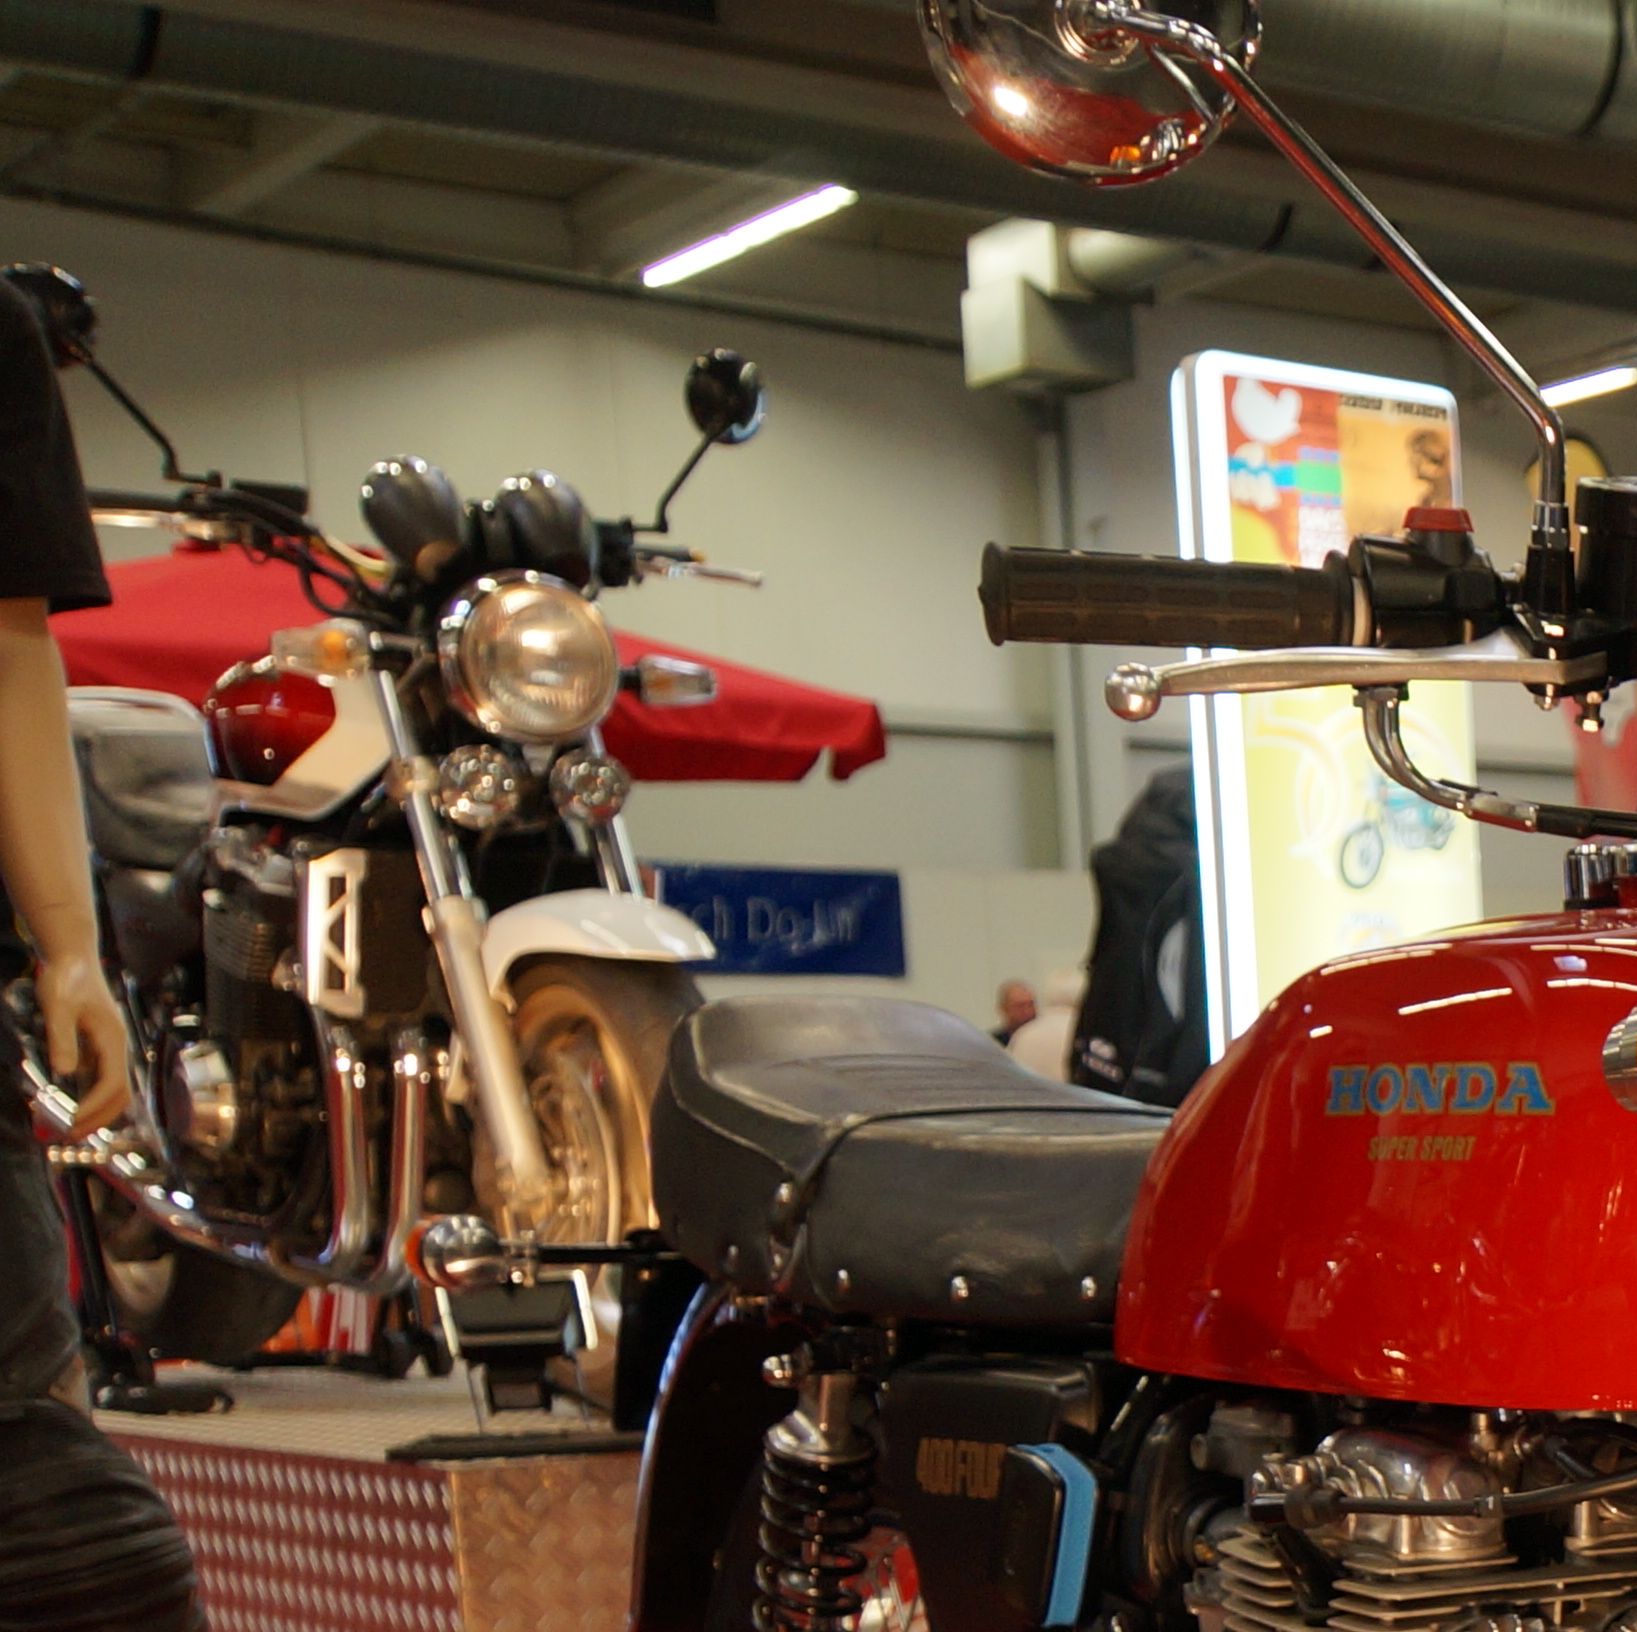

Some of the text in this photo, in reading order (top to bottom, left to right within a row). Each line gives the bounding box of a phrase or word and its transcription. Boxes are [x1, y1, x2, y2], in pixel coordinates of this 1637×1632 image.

[1325, 1062, 1556, 1116] HONDA
[1367, 1135, 1477, 1161] SUPER SPORT
